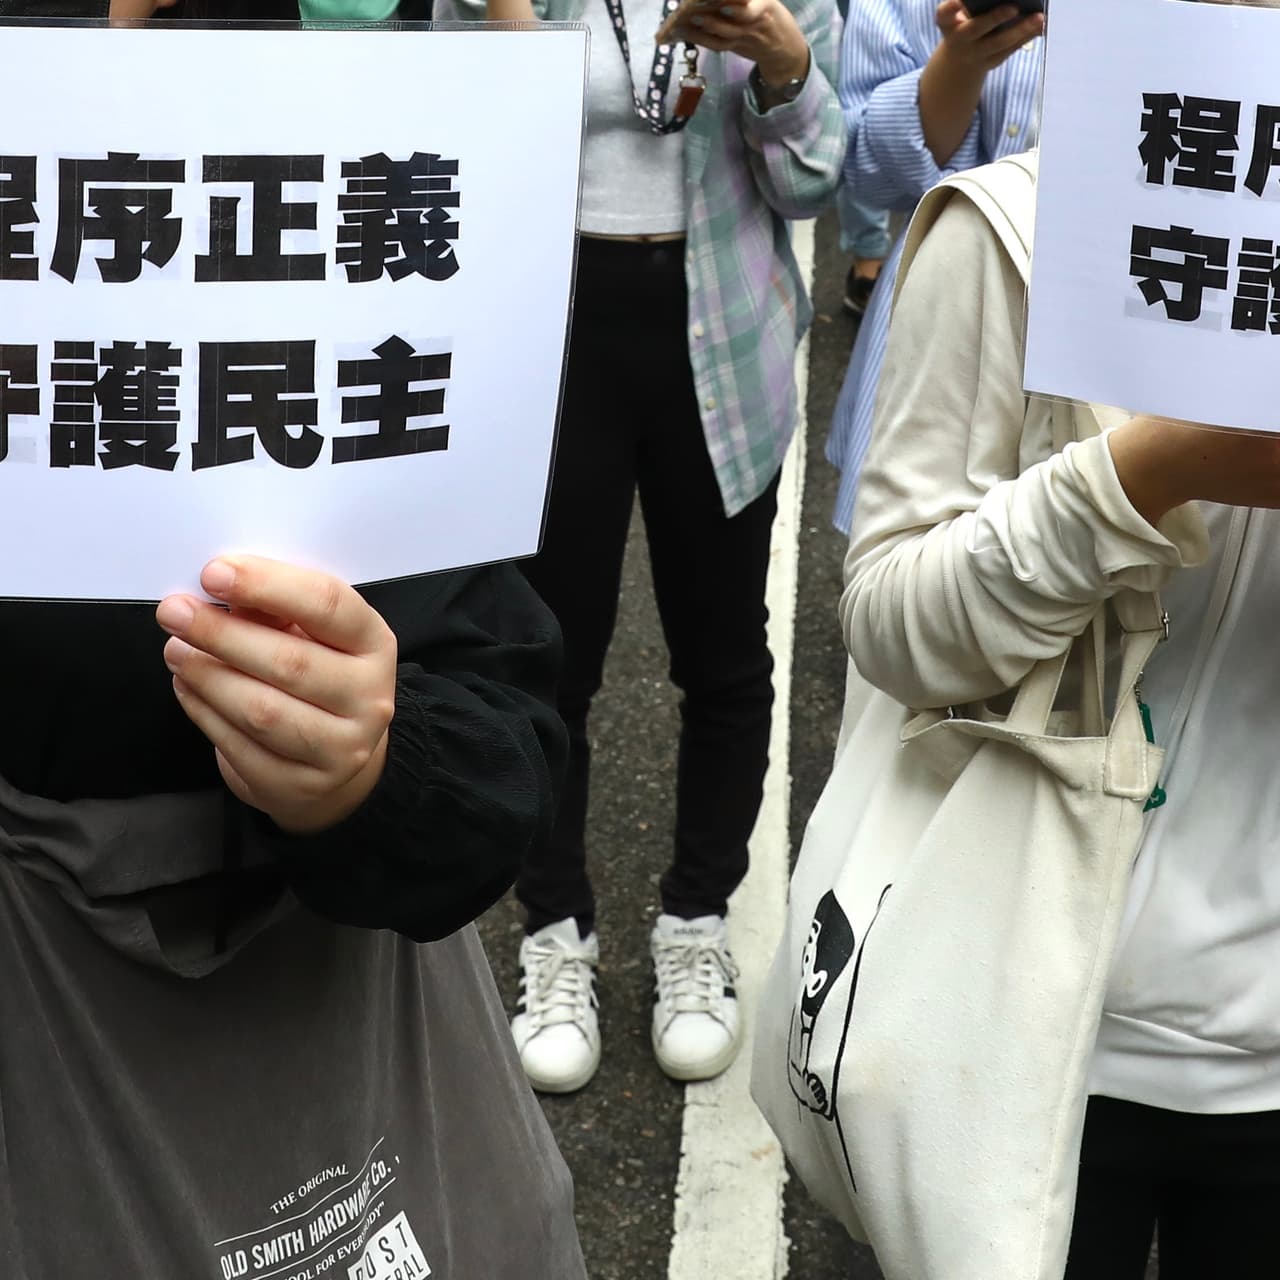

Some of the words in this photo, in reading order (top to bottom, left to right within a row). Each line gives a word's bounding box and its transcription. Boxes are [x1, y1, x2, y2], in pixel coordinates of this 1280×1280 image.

[269, 1191, 297, 1215] THE
[298, 1163, 349, 1197] ORIGINAL
[220, 1249, 248, 1280] OLD
[251, 1228, 305, 1269] SMITH
[308, 1172, 371, 1247] HARDWARE
[315, 1254, 336, 1275] FOR
